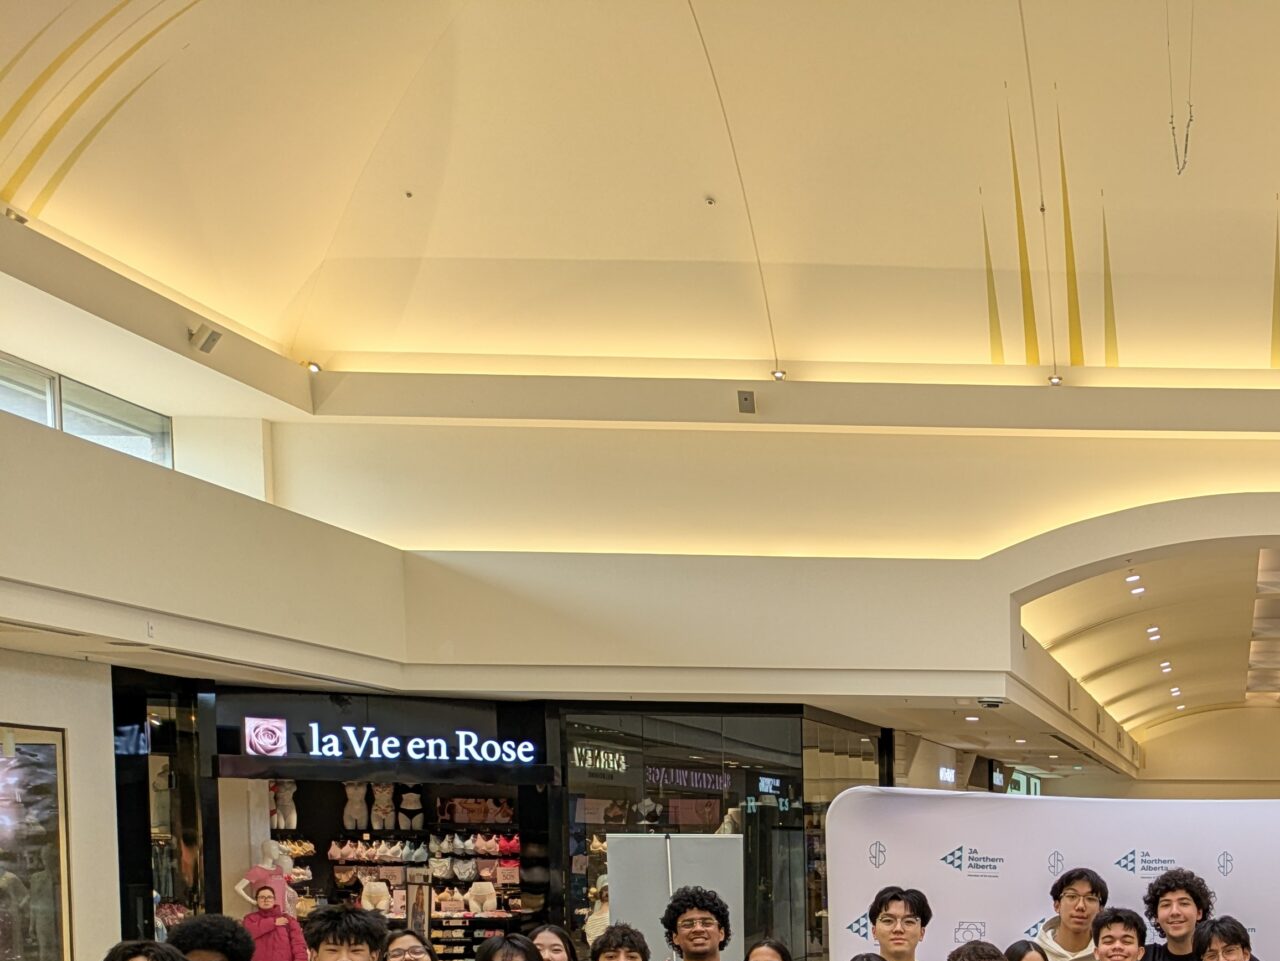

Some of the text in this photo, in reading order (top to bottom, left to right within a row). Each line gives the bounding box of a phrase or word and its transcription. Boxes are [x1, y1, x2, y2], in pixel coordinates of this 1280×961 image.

[308, 722, 535, 763] la Vie en Rose
[968, 855, 1004, 863] Northern
